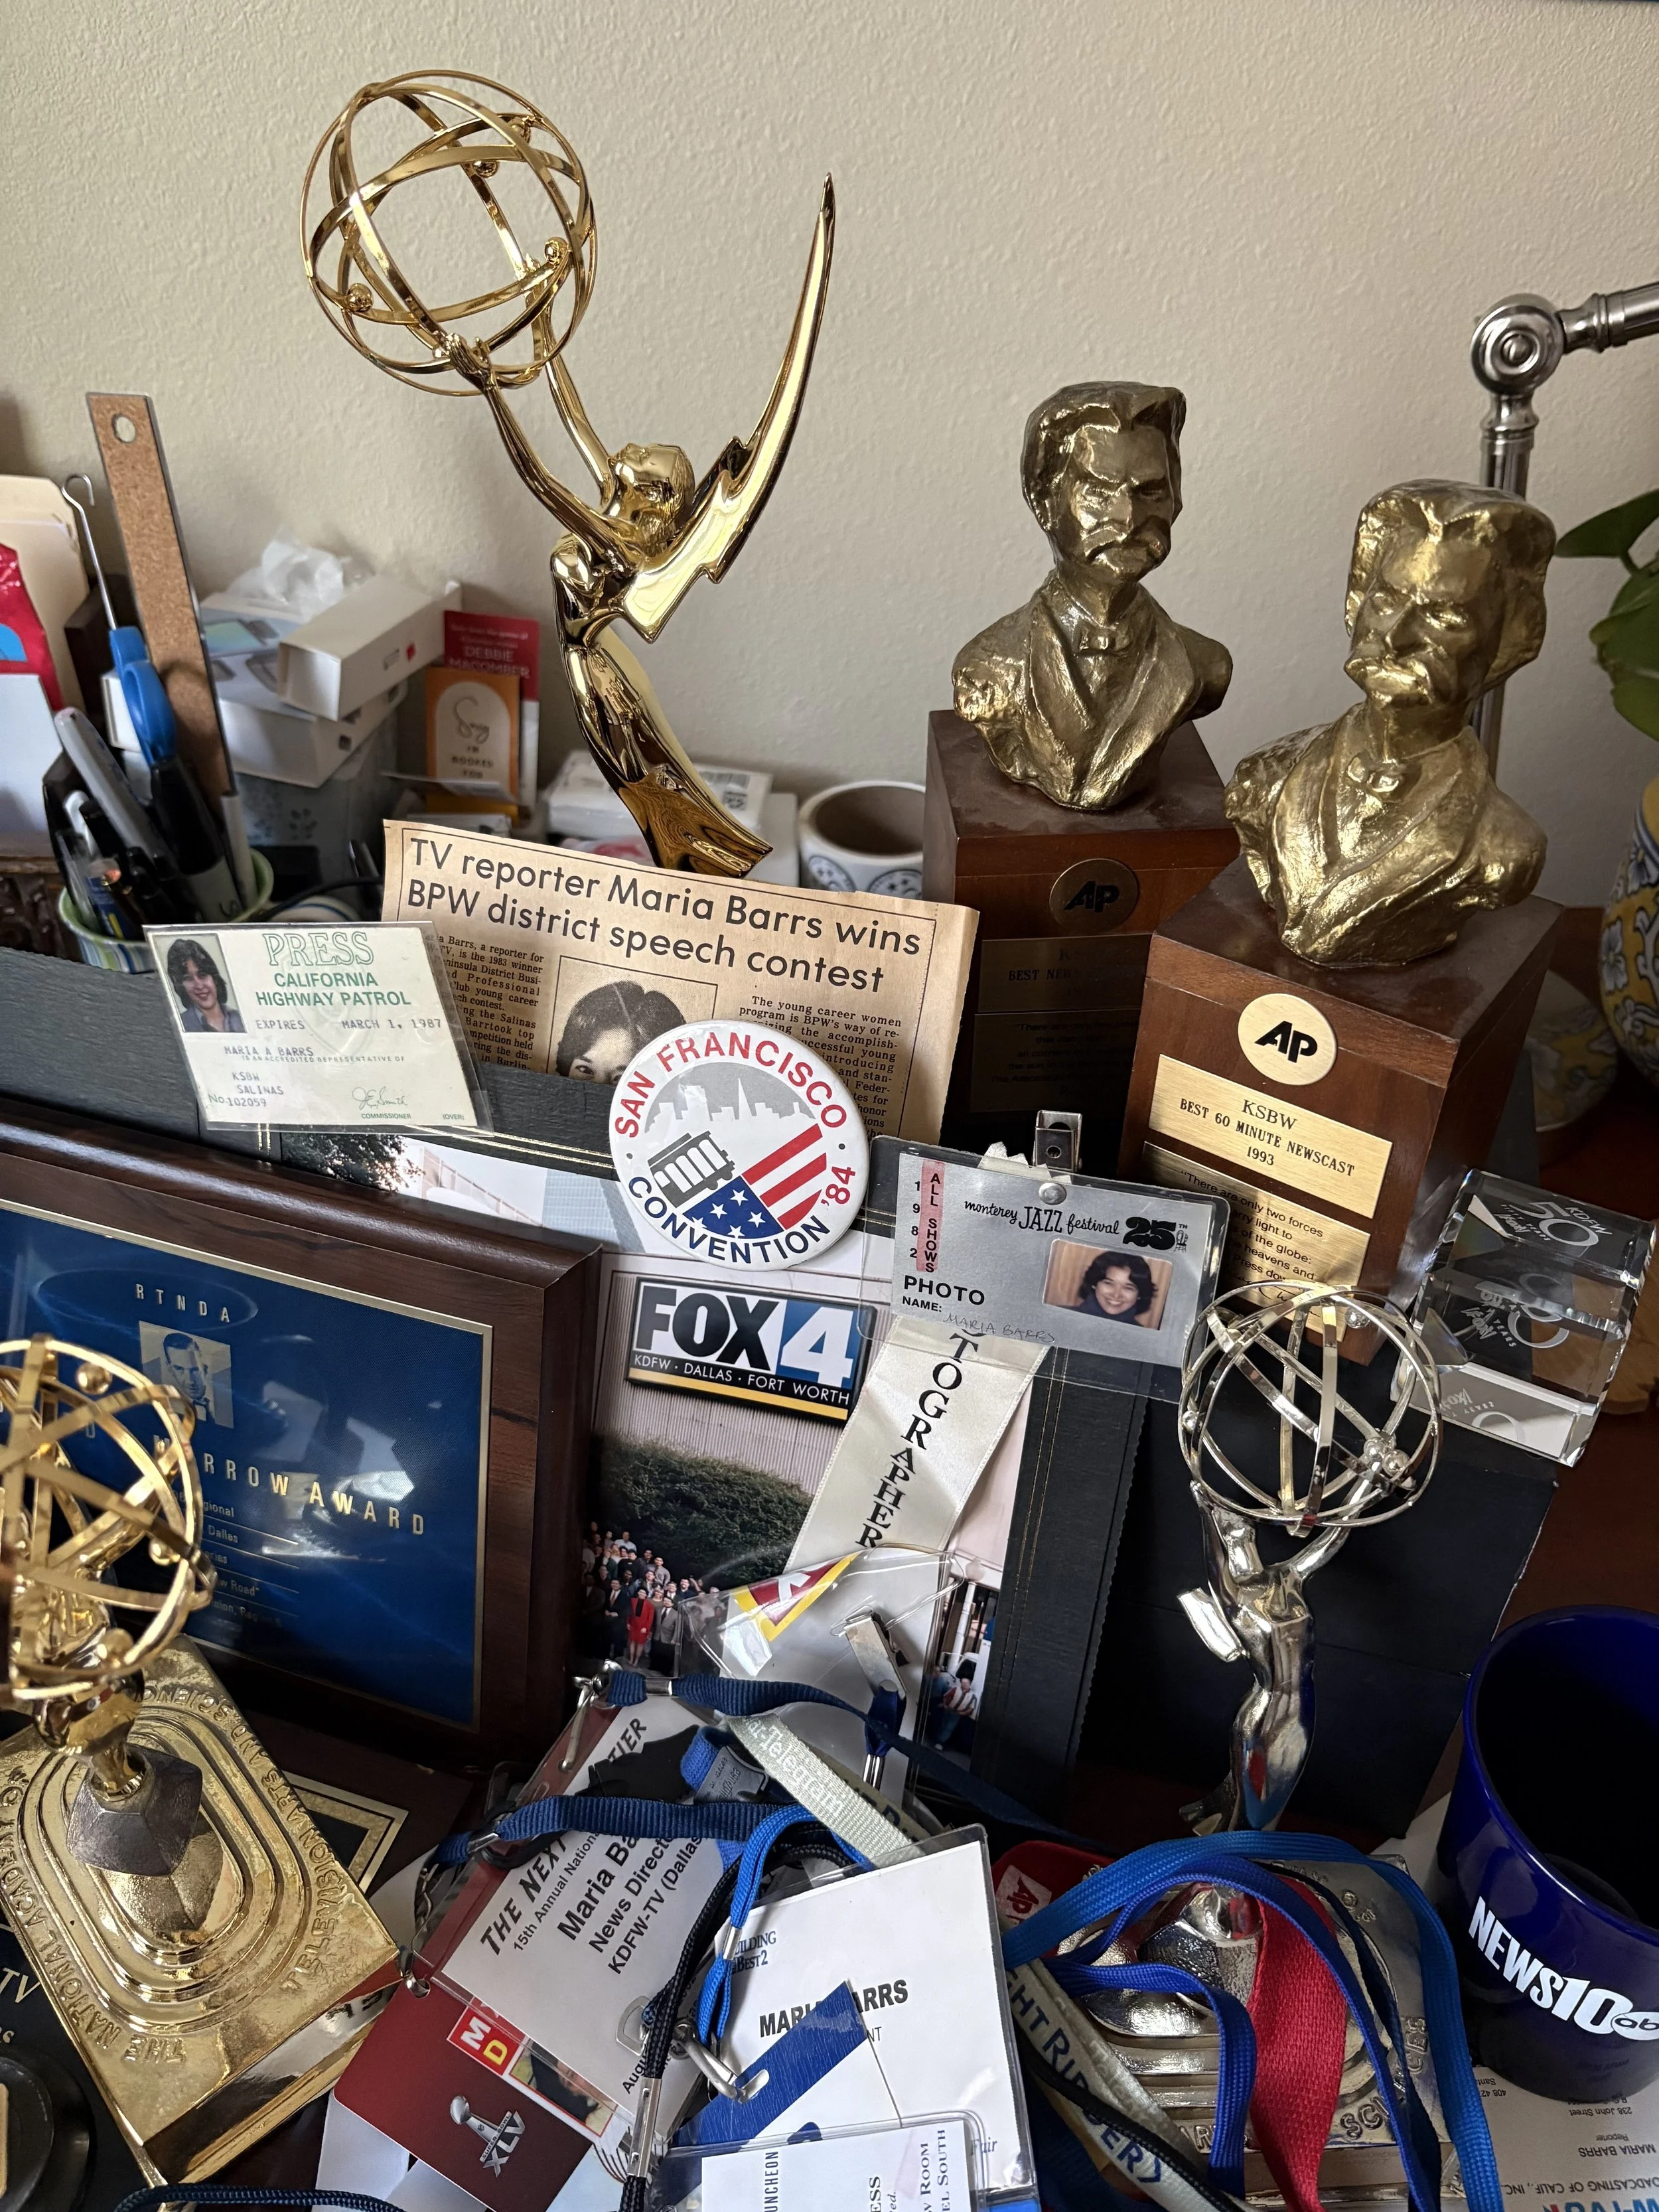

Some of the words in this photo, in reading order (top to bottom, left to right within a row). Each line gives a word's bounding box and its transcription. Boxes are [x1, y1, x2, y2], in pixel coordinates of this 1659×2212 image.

[410, 838, 452, 869] TV
[462, 855, 600, 898] reporter
[607, 874, 714, 921] Maria
[726, 895, 822, 939] Barrs
[837, 920, 920, 956] wins
[1064, 881, 1119, 913] AP
[263, 932, 374, 966] PRESS
[407, 879, 480, 917] BPW
[488, 893, 601, 942] district
[609, 926, 735, 968] speech
[747, 952, 884, 993] contest
[449, 936, 476, 950] Barrs,
[490, 945, 528, 960] reporter
[531, 952, 544, 963] for
[459, 950, 467, 958] is
[471, 952, 485, 962] the
[489, 956, 507, 967] 1983
[512, 961, 543, 974] winner
[480, 965, 514, 980] District
[518, 972, 541, 985] Busi-
[274, 972, 379, 988] CALIFORNIA
[467, 973, 540, 996] Professional
[255, 992, 333, 1006] HIGHWAY
[340, 991, 411, 1005] PATROL
[470, 996, 504, 1011] contest.
[476, 988, 503, 1001] young
[509, 995, 539, 1007] career
[752, 995, 772, 1007] The
[778, 1001, 812, 1015] young
[818, 1007, 855, 1019] career
[861, 1014, 902, 1027] women
[256, 1019, 305, 1029] EXPIRES
[342, 1019, 380, 1029] MARCH
[411, 1019, 441, 1029] 1987
[480, 1009, 495, 1020] the
[500, 1013, 536, 1029] Salinas
[739, 1005, 785, 1020] program
[790, 1013, 798, 1023] is
[804, 1015, 839, 1029] BPW's
[844, 1023, 865, 1034] way
[870, 1027, 881, 1036] of
[514, 1038, 534, 1051] held
[518, 1029, 535, 1041] top
[802, 1027, 818, 1037] the
[828, 1032, 898, 1049] accomplish-
[1254, 1021, 1317, 1063] AP
[224, 1046, 258, 1055] MARIA
[278, 1047, 313, 1056] BARRS
[497, 1045, 511, 1056] the
[516, 1049, 532, 1061] dis-
[822, 1052, 895, 1073] introducing
[861, 1048, 896, 1062] young
[614, 1071, 656, 1138] SAN
[656, 1031, 847, 1128] FRANCISCO
[839, 1067, 858, 1078] and
[863, 1071, 892, 1082] stan-
[855, 1081, 891, 1093] Feder-
[228, 1097, 267, 1107] 102059
[237, 1085, 284, 1095] SALINAS
[873, 1095, 888, 1106] for
[1242, 1099, 1297, 1130] KSBW
[1180, 1098, 1209, 1118] BEST
[1215, 1112, 1230, 1127] 60
[1236, 1120, 1281, 1147] MINUTE
[1287, 1141, 1354, 1177] NEWSCAST
[1247, 1146, 1275, 1166] 1993
[929, 1173, 941, 1207] ALL
[628, 1176, 830, 1264] CONVENTION
[821, 1167, 856, 1206] '84
[964, 1201, 1018, 1224] monterey
[1018, 1207, 1063, 1232] JAZZ
[1066, 1214, 1119, 1234] festival
[1123, 1217, 1178, 1251] 25
[1220, 1189, 1237, 1201] are
[1241, 1194, 1263, 1213] only
[1267, 1207, 1285, 1222] two
[1288, 1217, 1323, 1237] forces
[1565, 1207, 1613, 1234] KDFW
[1256, 1217, 1279, 1236] light
[1282, 1228, 1292, 1240] to
[924, 1218, 938, 1273] SHOWS
[1241, 1227, 1254, 1239] of
[1256, 1233, 1273, 1248] the
[1277, 1240, 1311, 1264] globe:
[1245, 1245, 1290, 1270] heavens
[1293, 1266, 1315, 1280] and
[135, 1284, 230, 1323] RTNDA
[904, 1275, 985, 1305] PHOTO
[902, 1296, 942, 1313] NAME:
[634, 1286, 779, 1370] FOX
[780, 1305, 855, 1389] 4
[943, 1313, 996, 1337] MARIA
[1003, 1326, 1055, 1343] BARRS
[634, 1355, 672, 1371] KDFW
[684, 1363, 733, 1382] DALLAS
[747, 1374, 784, 1392] FORT
[793, 1382, 850, 1406] WORTH
[855, 1329, 978, 1548] TOGRAPHER
[309, 1480, 426, 1536] AWARD
[208, 1524, 238, 1543] Dallas
[230, 1721, 269, 1766] AND
[259, 1769, 305, 1829] ARTS
[480, 1897, 522, 1955] THE
[519, 1838, 567, 1903] NEXT
[557, 1868, 615, 1941] Maria
[279, 1828, 343, 1996] TELEVISION
[514, 1921, 537, 1951] 15th
[534, 1879, 569, 1923] Annual
[588, 1897, 632, 1954] News
[608, 1889, 665, 1975] KDFW-TV
[38, 1930, 122, 2049] NATIONAL
[1493, 2089, 1506, 2097] 408
[1595, 2108, 1615, 2116] John
[1618, 2106, 1632, 2115] 238
[480, 2134, 498, 2160] SUPER
[482, 2110, 526, 2178] XLV
[1577, 2146, 1617, 2157] BARRS
[1622, 2143, 1656, 2154] MARIA
[921, 2142, 930, 2196] ROOM
[938, 2129, 949, 2191] SOUTH
[1500, 2184, 1526, 2195] INC.
[1528, 2182, 1565, 2195] CALIF.,
[1569, 2181, 1584, 2192] OF
[1587, 2176, 1659, 2191] OADCASTING
